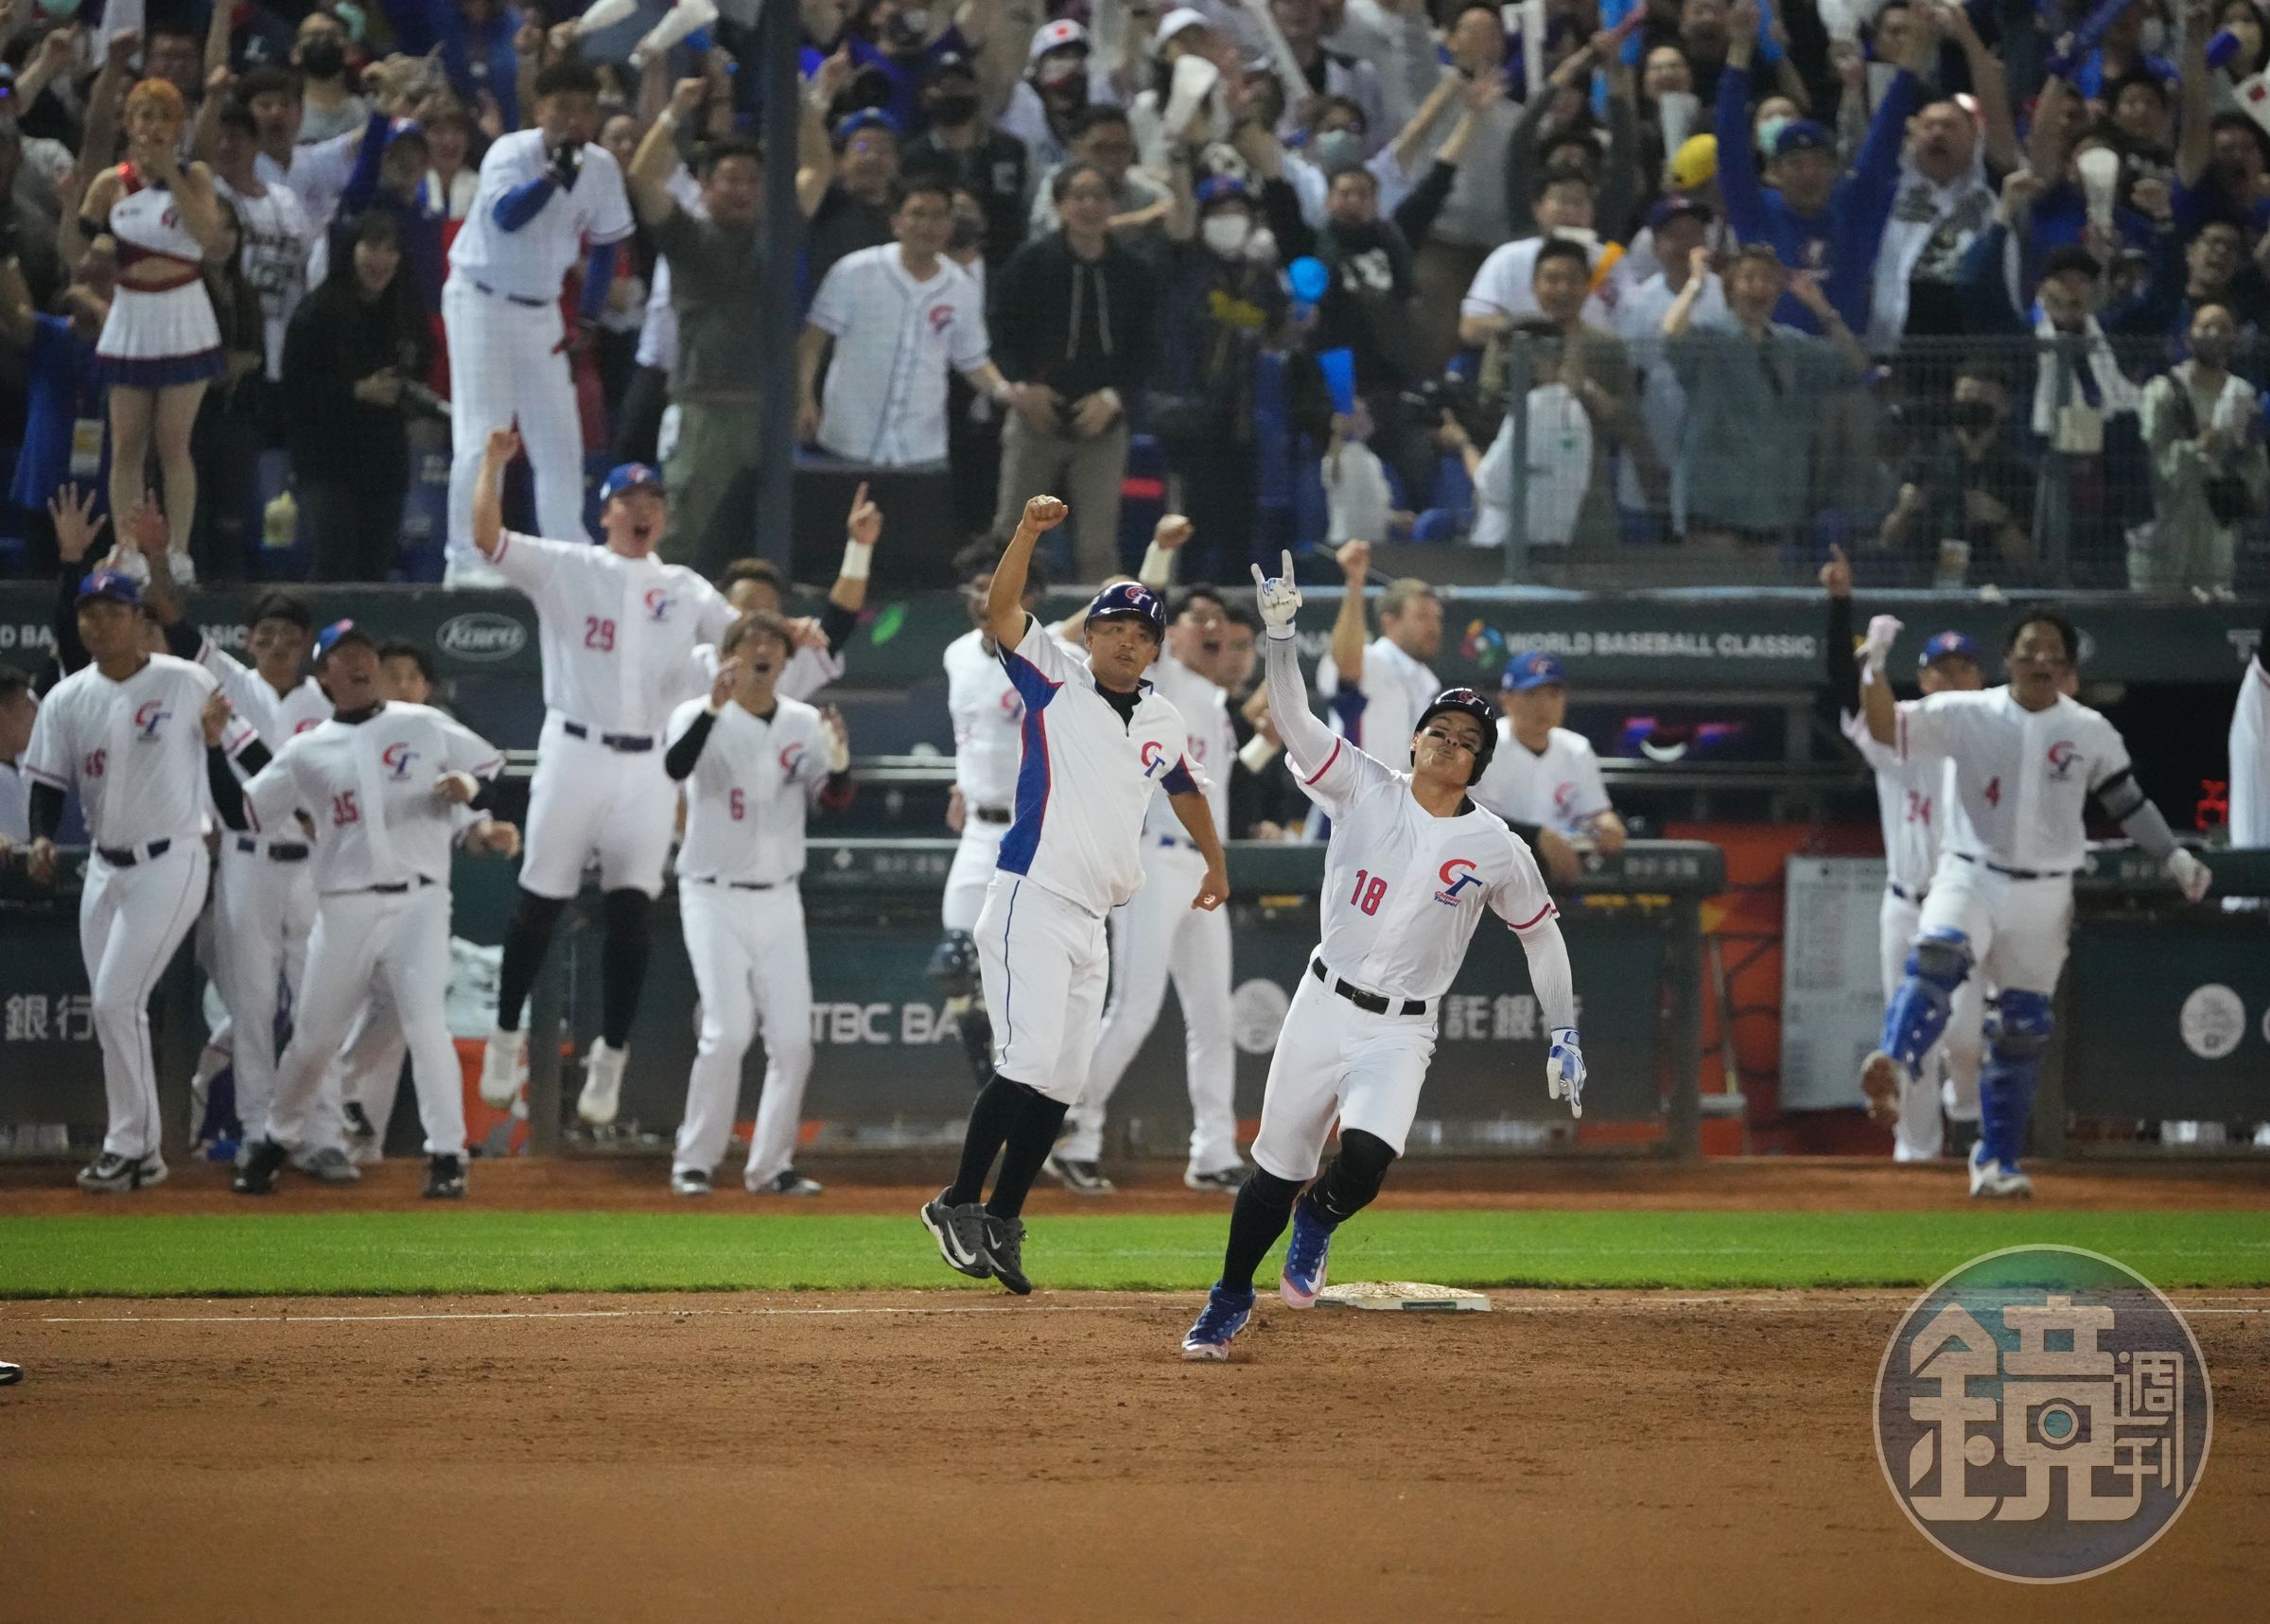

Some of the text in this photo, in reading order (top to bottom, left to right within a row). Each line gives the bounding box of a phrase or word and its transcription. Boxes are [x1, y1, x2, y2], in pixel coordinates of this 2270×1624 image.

[584, 615, 617, 652] 29
[1506, 632, 1817, 659] WORLD BASEBALL CLASSIC
[729, 787, 745, 822] 6
[1350, 868, 1388, 917] 18
[6, 994, 94, 1040] 銀行
[811, 1003, 963, 1042] TBC BA
[1444, 994, 1582, 1039] 託銀
